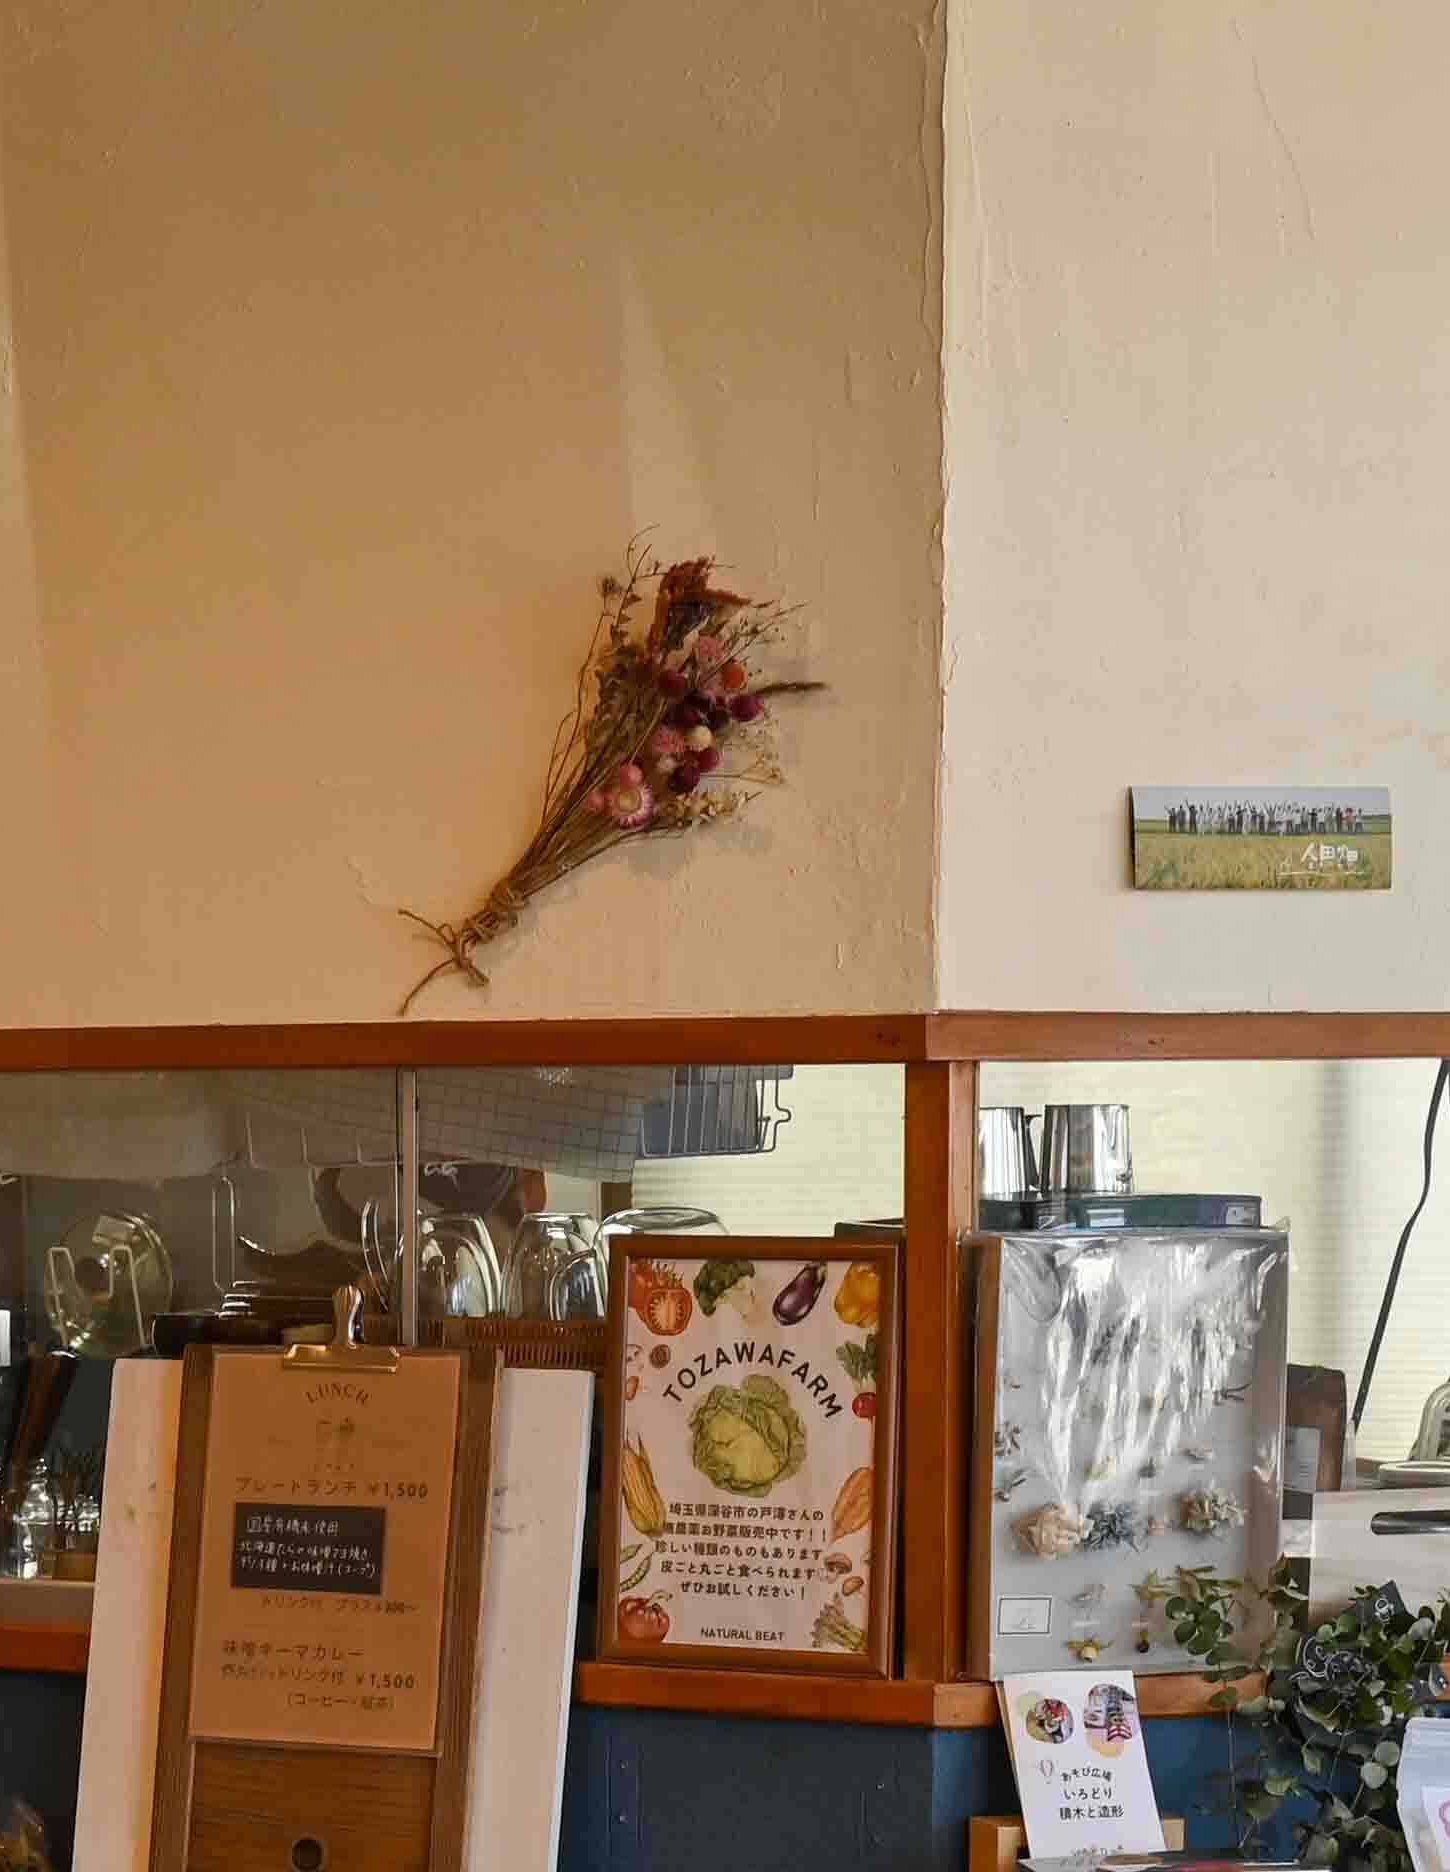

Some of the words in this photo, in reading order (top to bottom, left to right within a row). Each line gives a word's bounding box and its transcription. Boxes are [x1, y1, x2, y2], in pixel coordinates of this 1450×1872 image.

[662, 1341, 844, 1418] TOZAWAFARM
[305, 1382, 371, 1407] LUNCH
[236, 1477, 357, 1497] プレートランチ
[700, 1627, 753, 1641] NATURAL
[755, 1629, 786, 1641] BEAT
[1060, 1766, 1112, 1782] あそび広場
[1063, 1786, 1112, 1801] いろどり
[1059, 1804, 1125, 1820] 積木と造形
